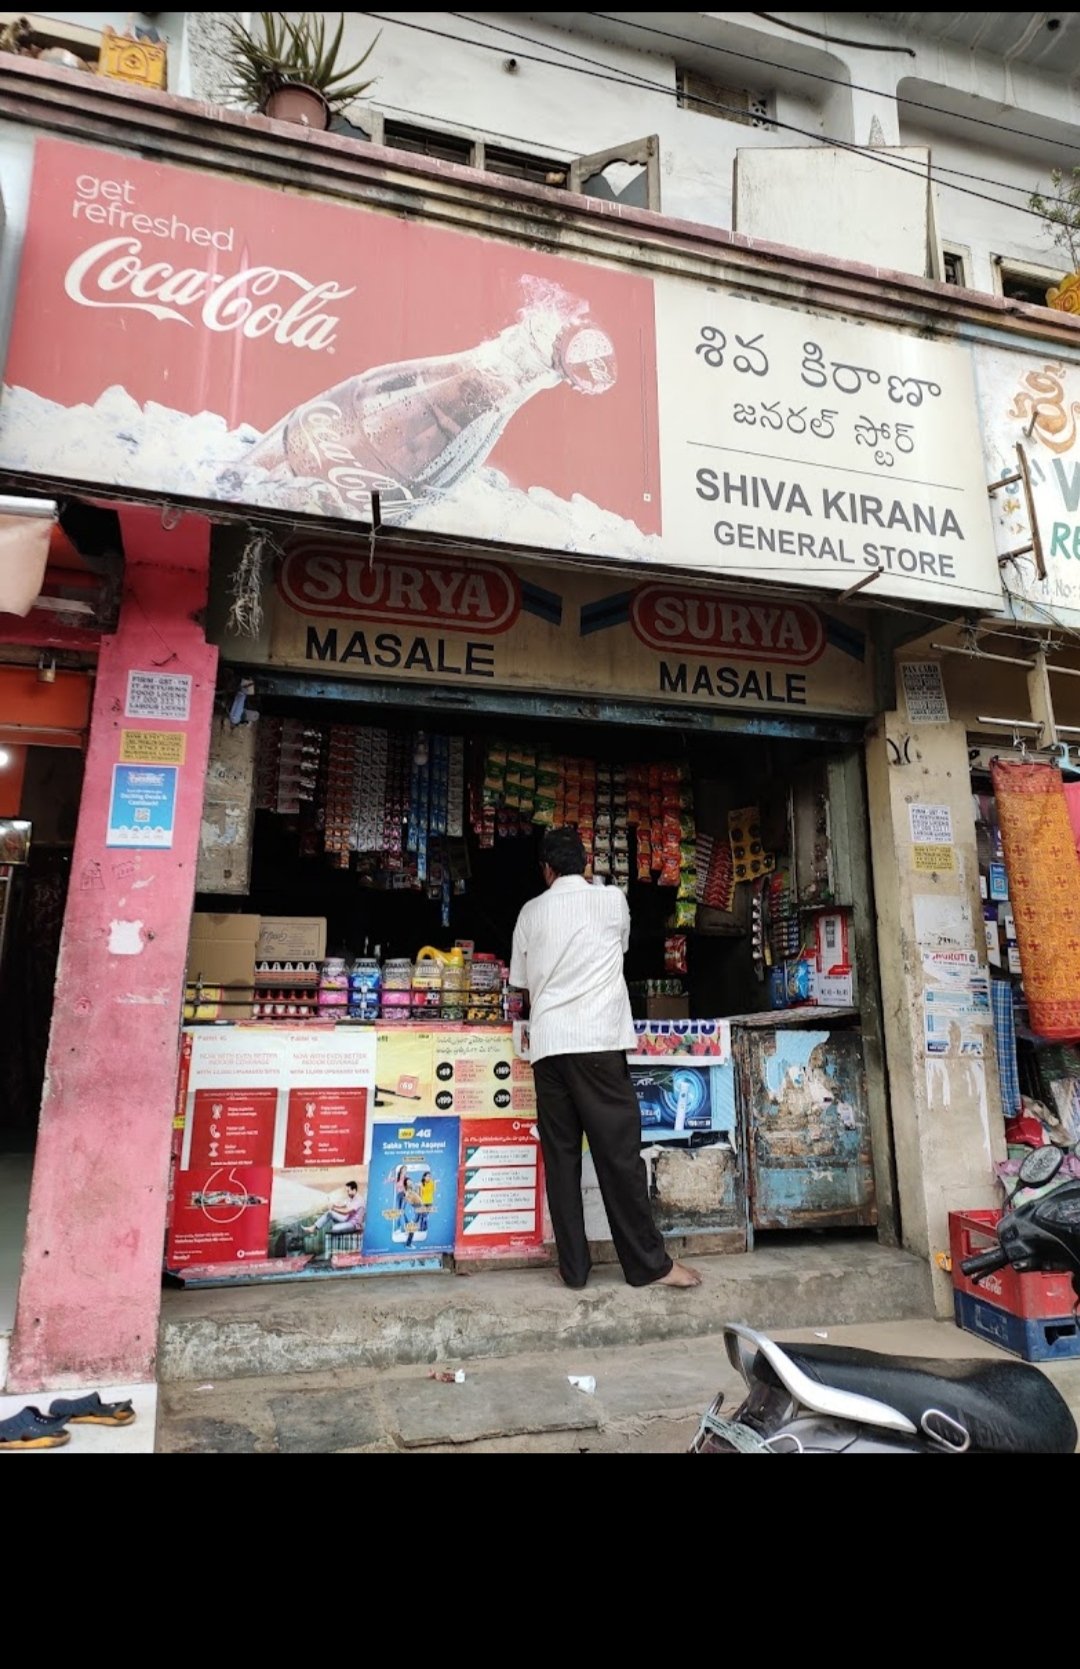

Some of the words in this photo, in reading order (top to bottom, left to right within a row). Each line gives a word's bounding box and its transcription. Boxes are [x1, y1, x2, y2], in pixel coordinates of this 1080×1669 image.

[76, 174, 136, 204] get
[72, 200, 234, 251] refreshed
[64, 236, 357, 352] Coca-Cola
[695, 325, 769, 376] శివ
[801, 341, 942, 407] కిరాణా
[733, 401, 838, 439] జనరల్
[854, 415, 914, 467] స్టోర్
[695, 467, 812, 517] SHIVA
[822, 488, 965, 540] KIRANA
[714, 520, 855, 564] GENERAL
[863, 543, 956, 578] STORE
[303, 555, 497, 619] SURYA
[306, 626, 495, 677] MASALE
[654, 598, 808, 652] SURYA
[659, 662, 807, 704] MASALE
[404, 1141, 420, 1149] Time
[416, 1128, 432, 1138] 4G
